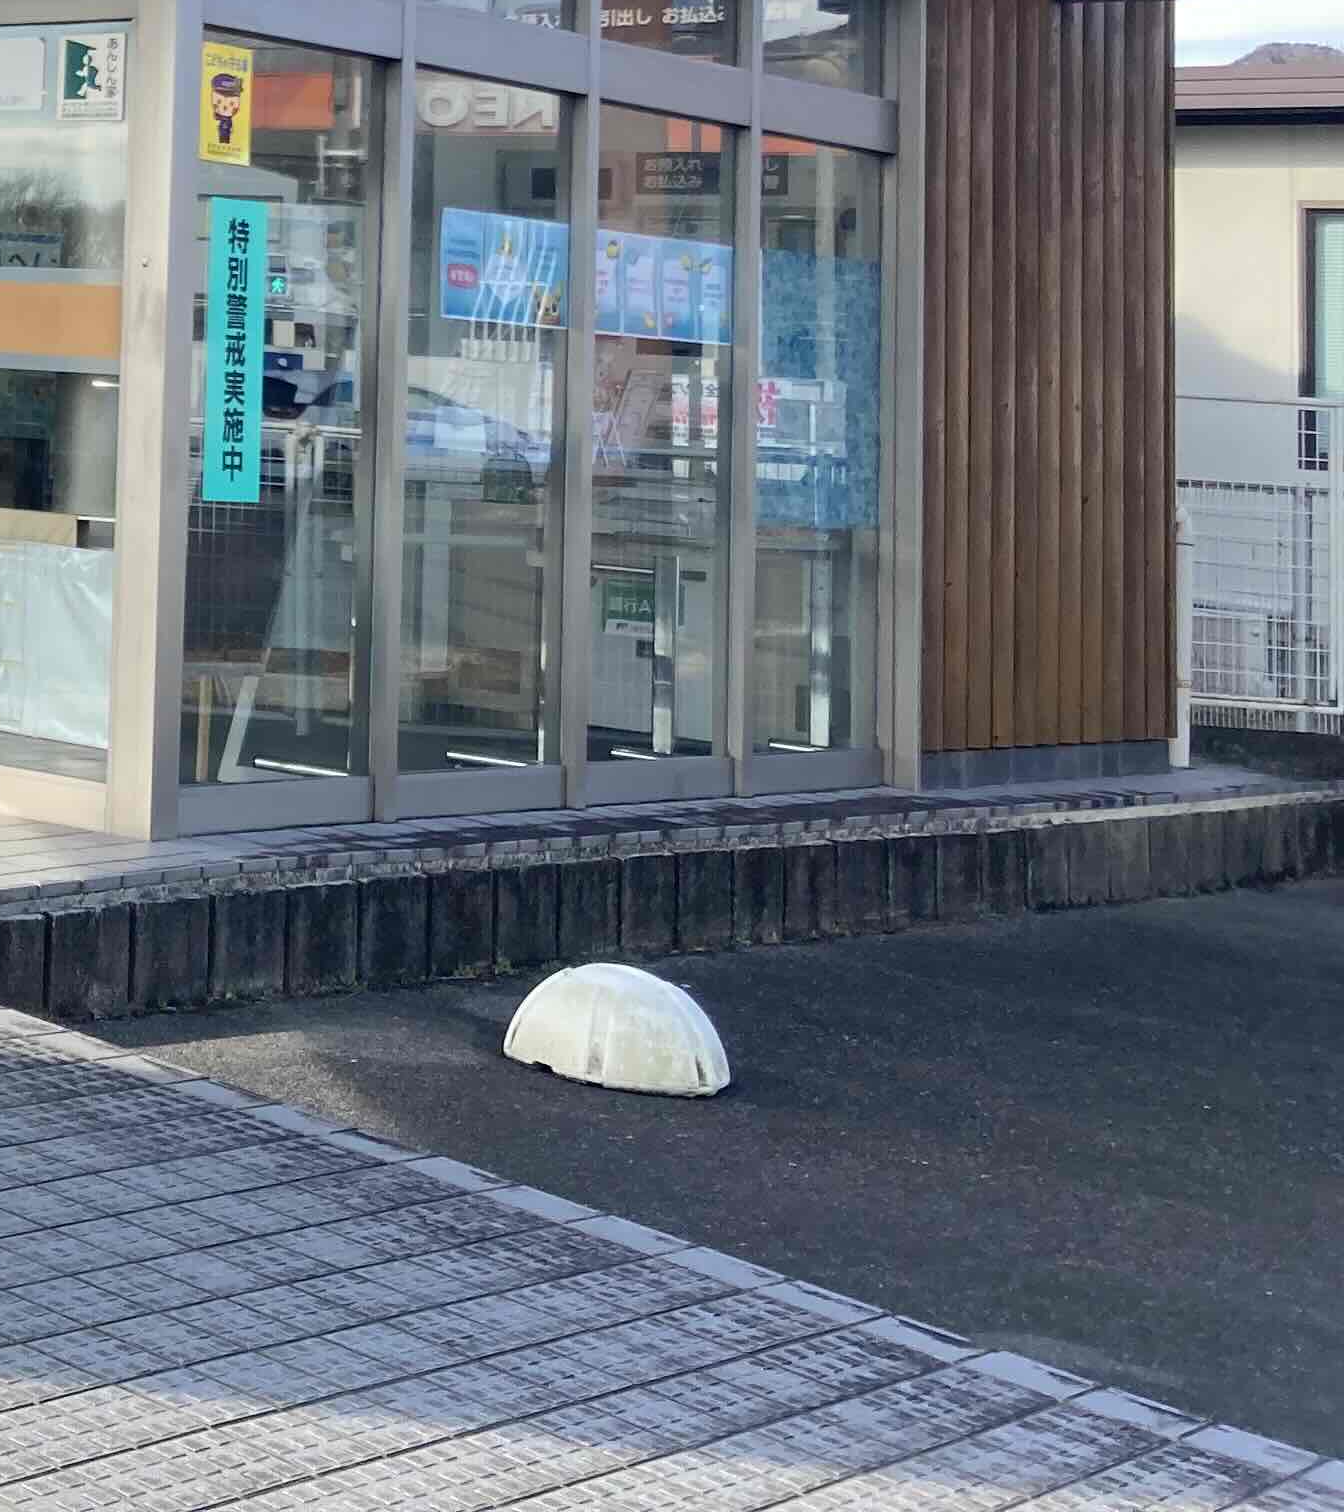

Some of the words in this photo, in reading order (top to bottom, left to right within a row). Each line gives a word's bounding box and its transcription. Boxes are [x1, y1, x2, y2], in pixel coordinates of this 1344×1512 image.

[599, 7, 652, 26] 引出し
[222, 217, 251, 482] 特別警戒実施中
